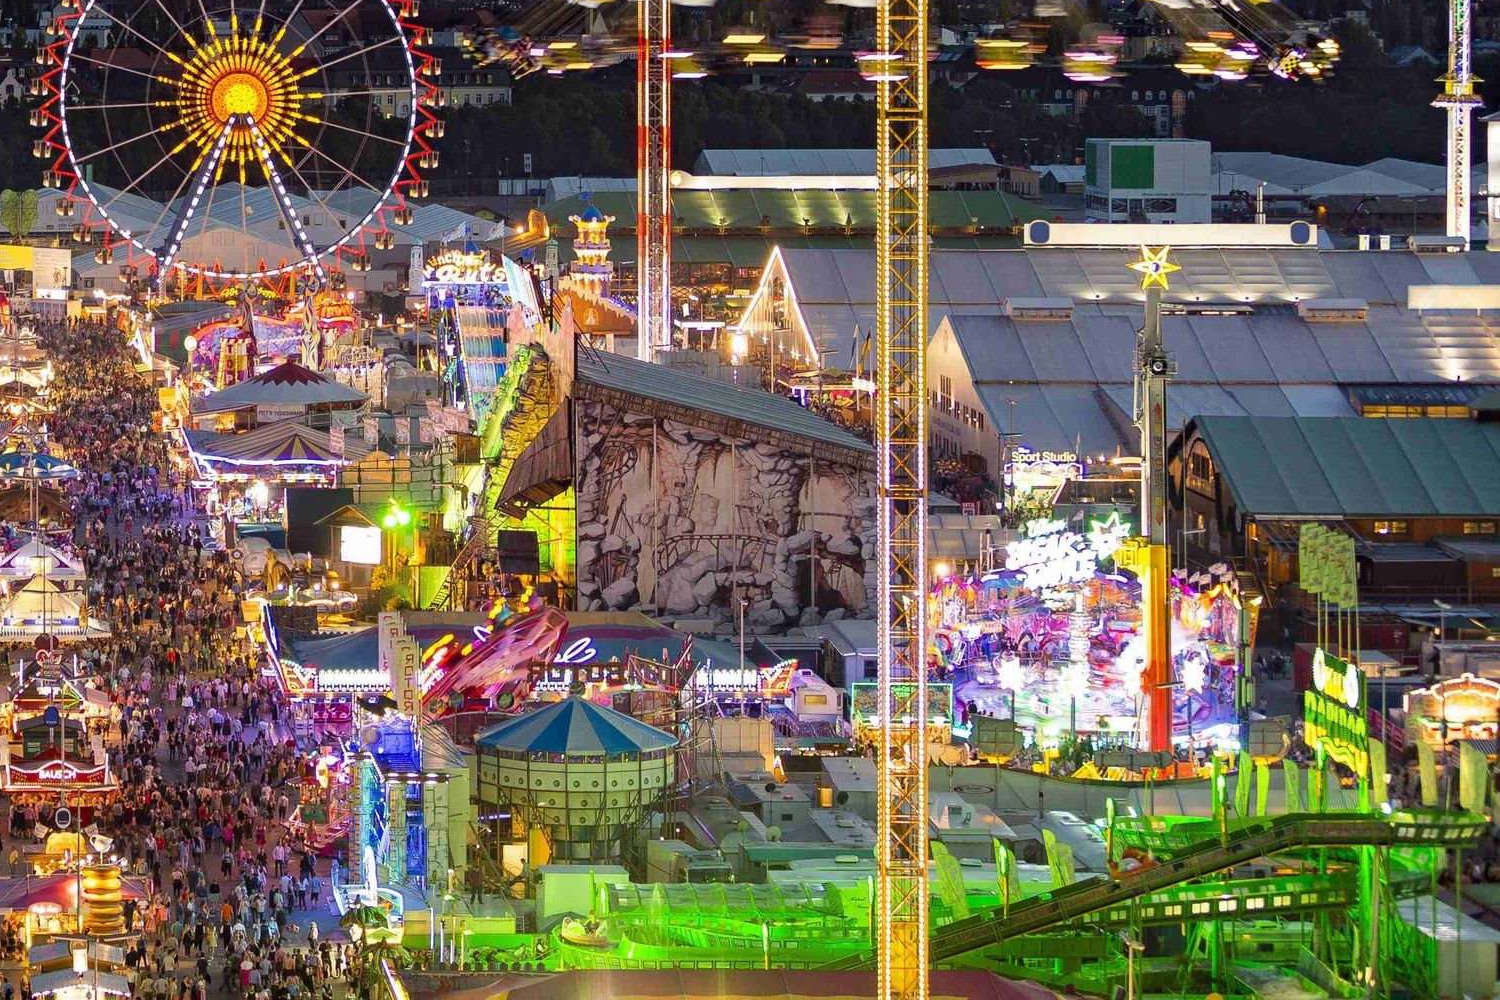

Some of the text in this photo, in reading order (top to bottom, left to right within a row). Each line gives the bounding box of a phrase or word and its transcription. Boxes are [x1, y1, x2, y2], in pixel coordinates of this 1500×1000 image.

[1012, 451, 1077, 463] Sport Studio
[39, 770, 77, 780] BAUSCH
